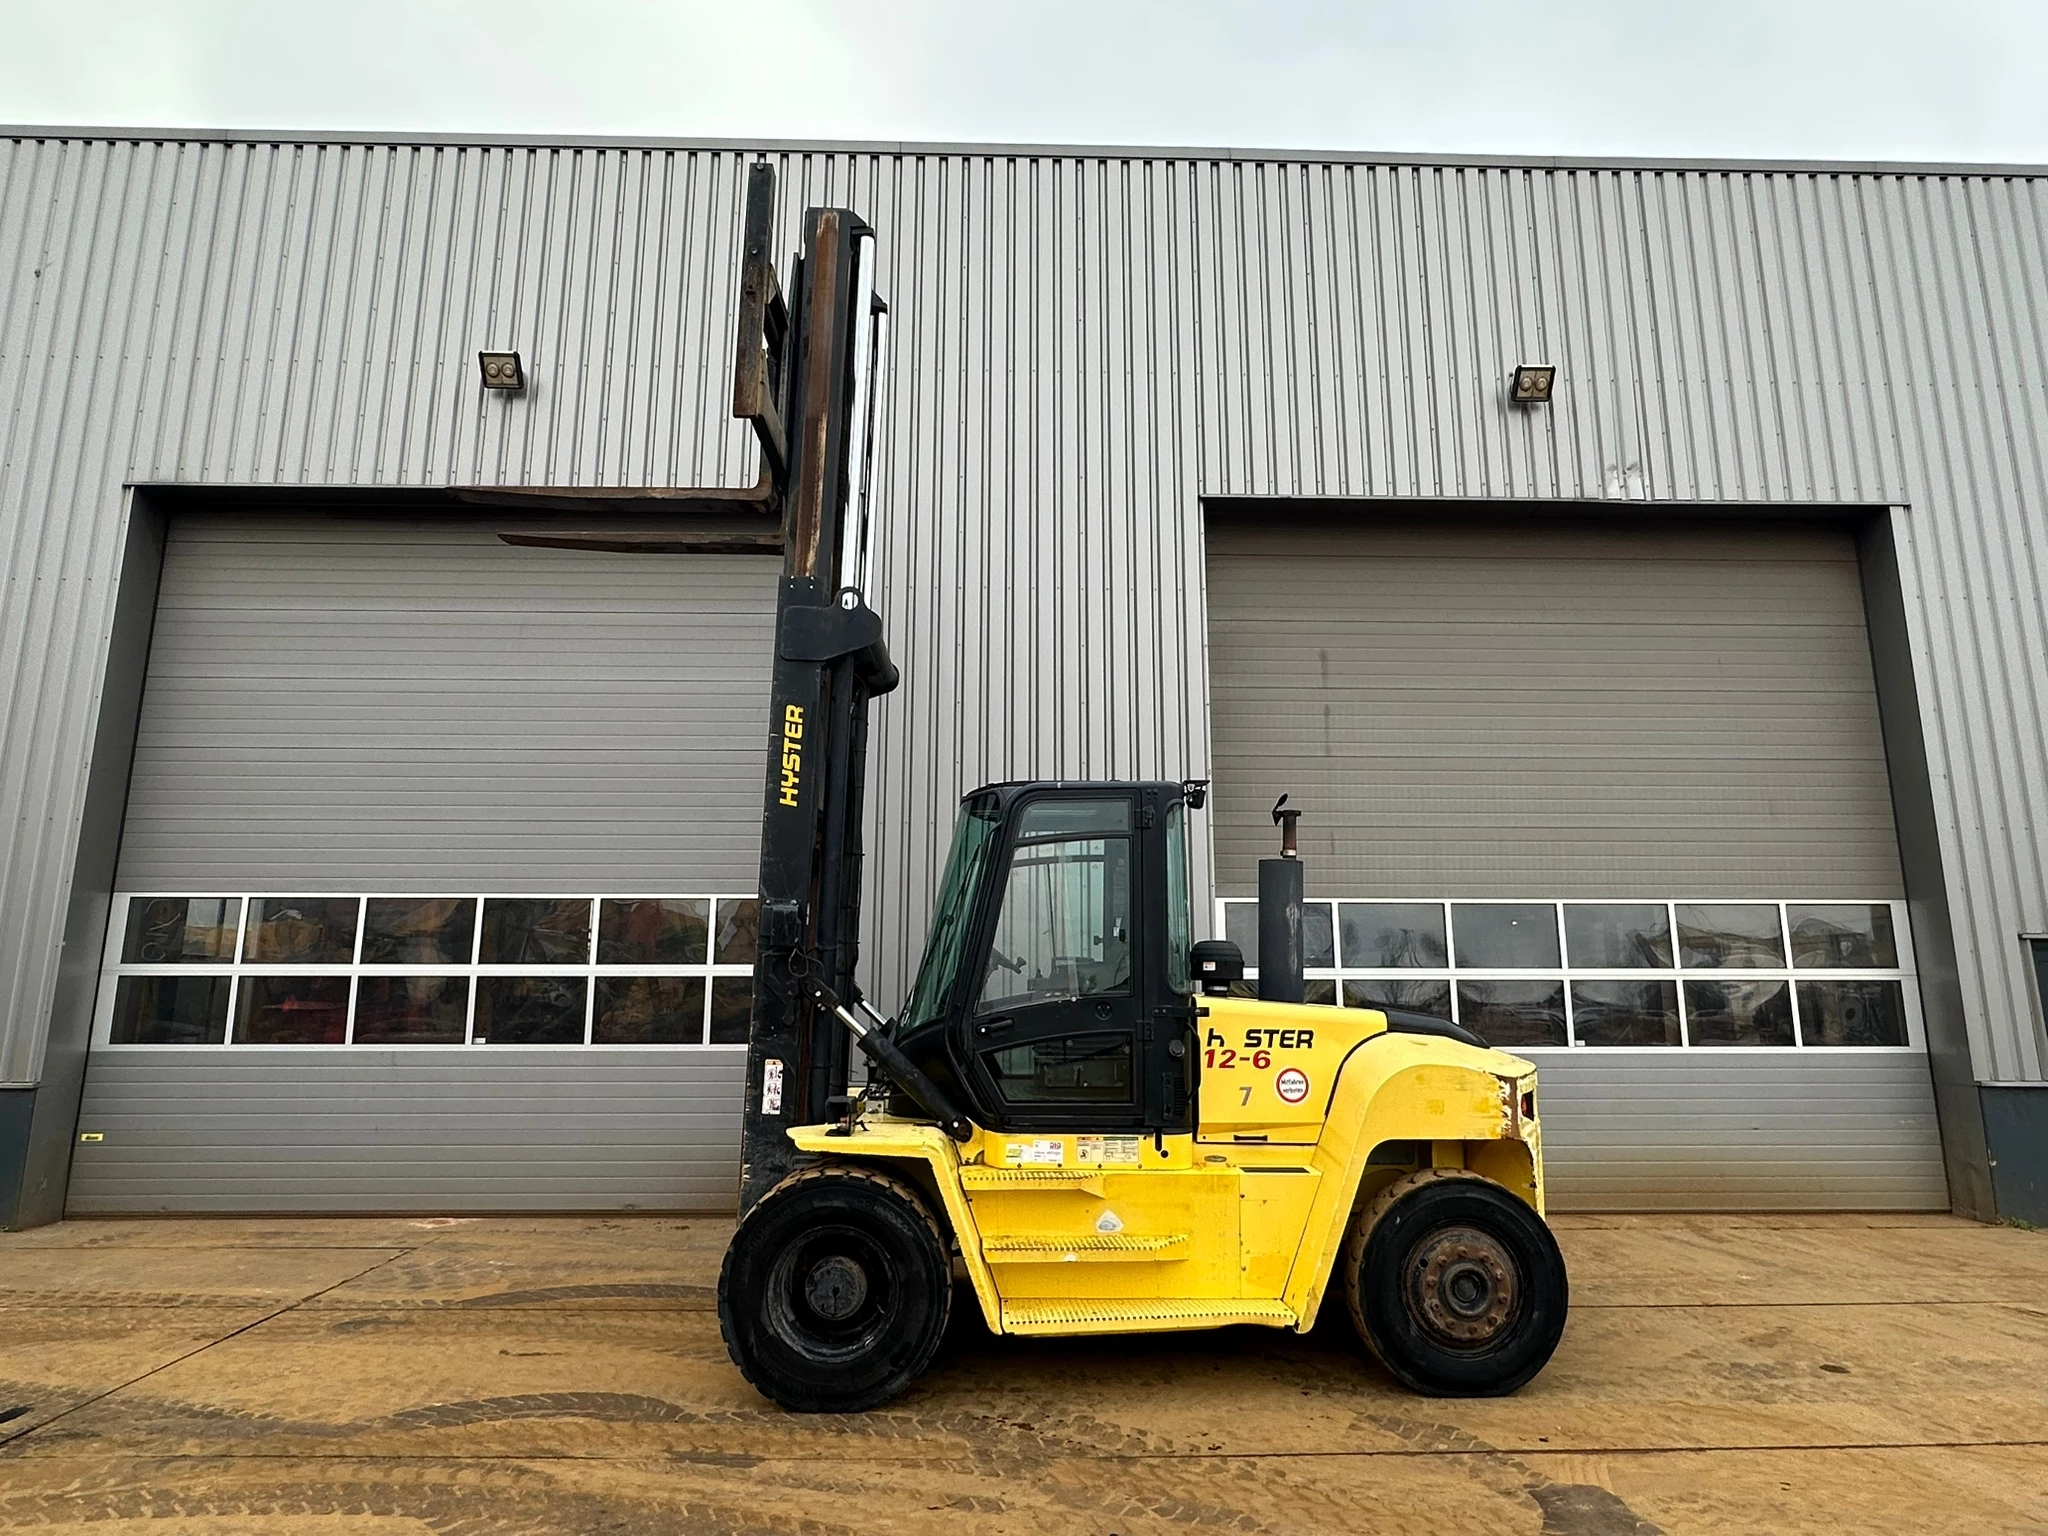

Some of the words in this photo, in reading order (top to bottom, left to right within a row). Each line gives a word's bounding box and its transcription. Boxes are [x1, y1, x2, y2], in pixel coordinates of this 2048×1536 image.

[779, 704, 804, 807] HYSTER
[1204, 1049, 1271, 1069] 12-6
[1239, 1086, 1252, 1106] 7
